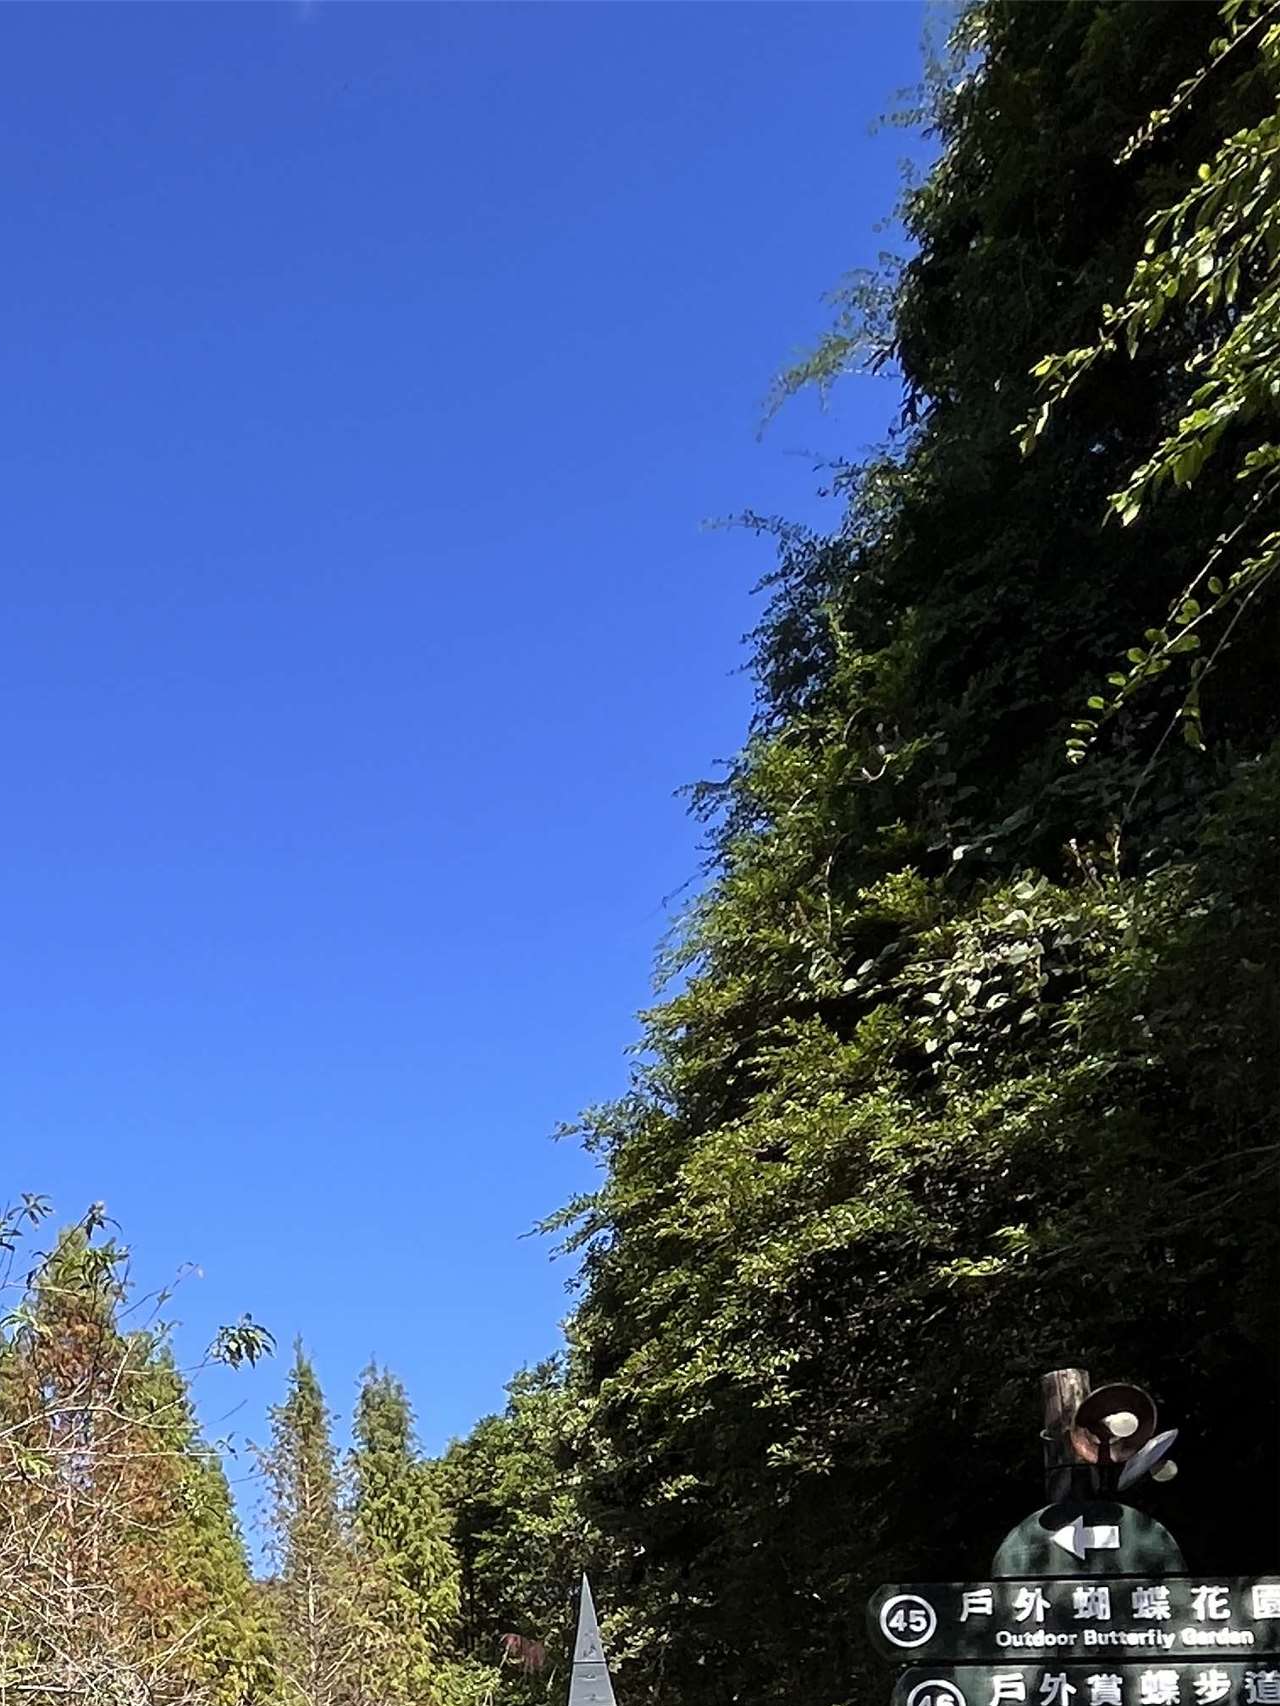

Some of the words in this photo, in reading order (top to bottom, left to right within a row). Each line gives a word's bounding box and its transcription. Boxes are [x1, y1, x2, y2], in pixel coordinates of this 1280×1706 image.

[887, 1609, 928, 1633] 45
[995, 1629, 1078, 1648] Outdoor
[1083, 1629, 1175, 1651] Butterfly
[1181, 1628, 1255, 1647] Garden
